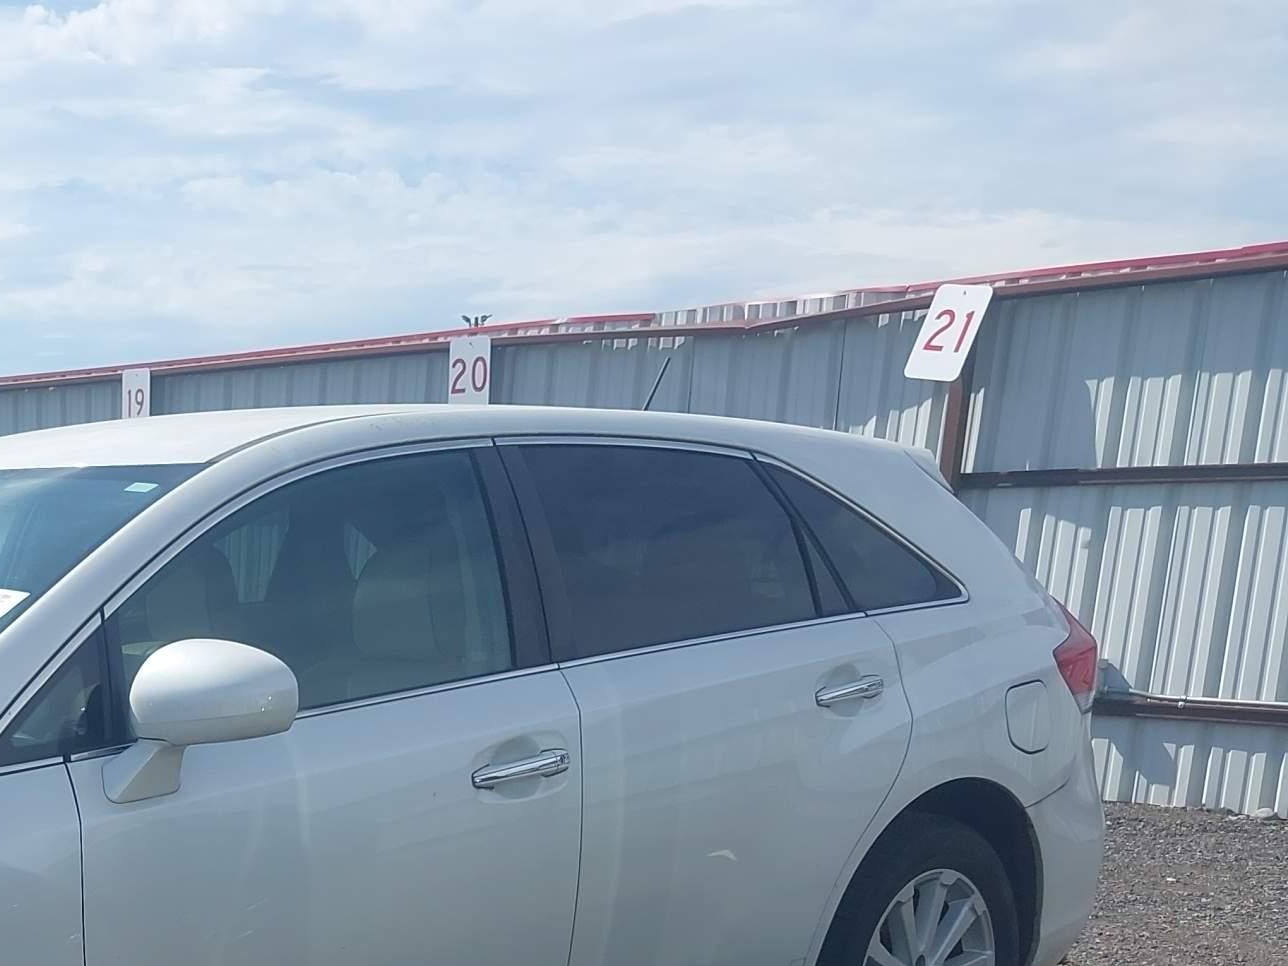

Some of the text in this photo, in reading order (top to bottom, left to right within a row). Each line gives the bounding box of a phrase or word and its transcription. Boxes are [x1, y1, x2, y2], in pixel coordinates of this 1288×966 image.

[922, 308, 975, 353] 21
[450, 356, 488, 395] 20
[127, 388, 145, 418] 19
